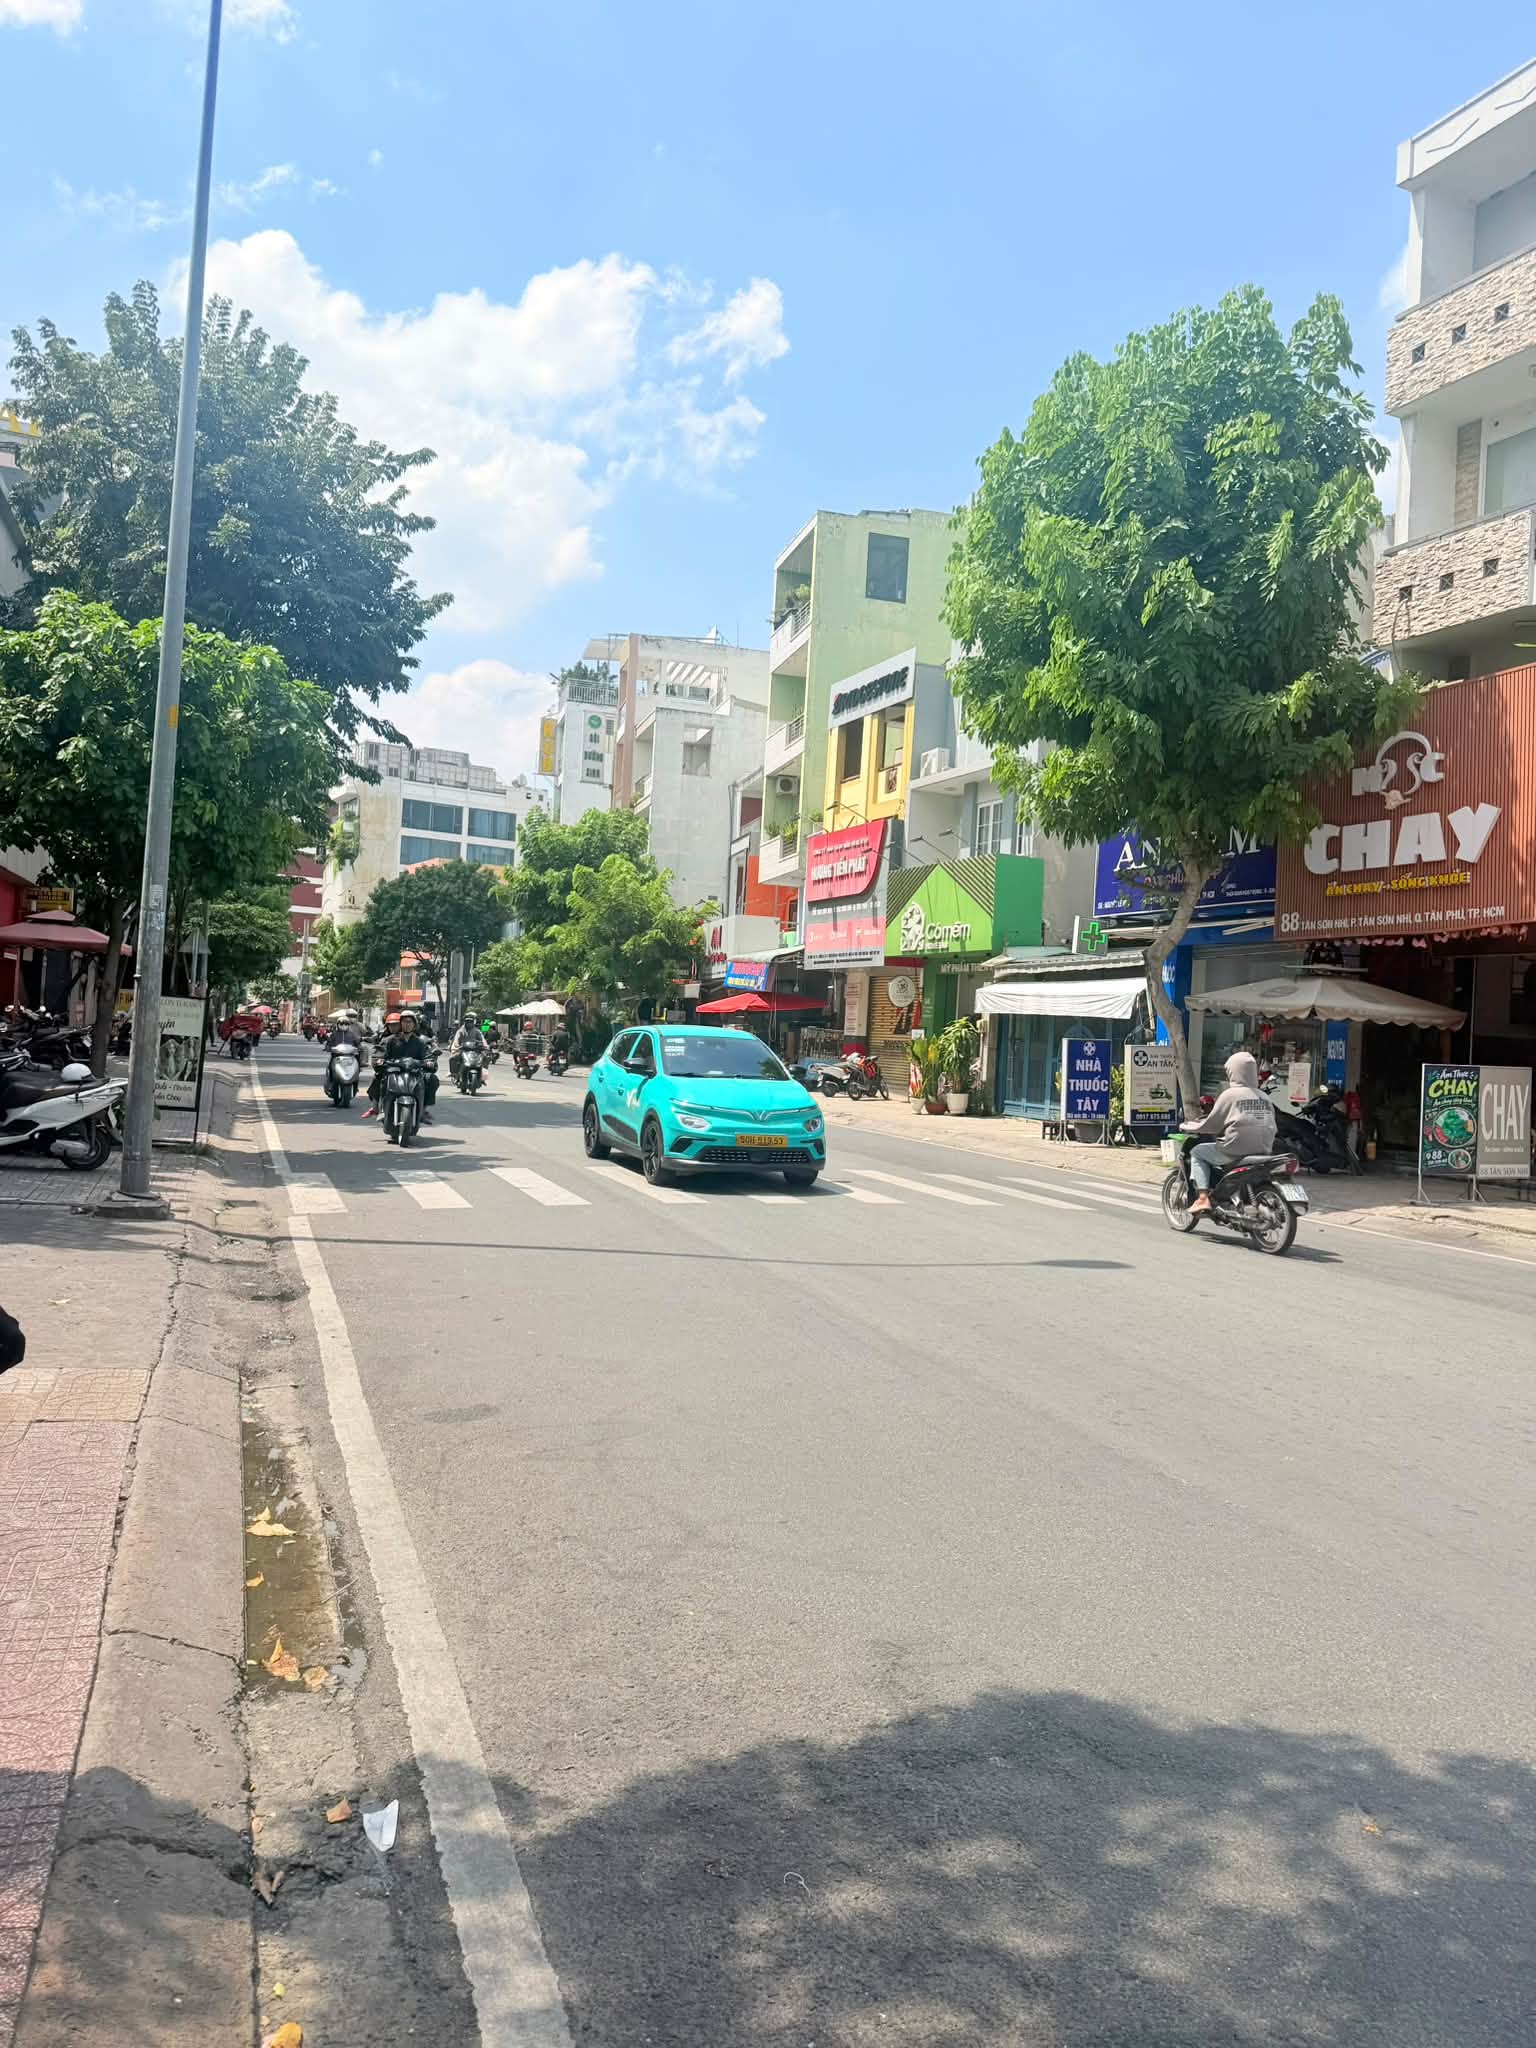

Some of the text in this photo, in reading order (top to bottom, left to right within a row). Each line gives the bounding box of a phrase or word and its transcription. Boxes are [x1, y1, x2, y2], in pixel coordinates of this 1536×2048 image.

[1304, 802, 1502, 875] CHAY
[1346, 880, 1382, 894] CHAY
[1281, 911, 1299, 932] 88
[1483, 905, 1505, 919] HCM
[1076, 1058, 1102, 1072] NHÀ
[1069, 1075, 1109, 1092] THUỐC
[1429, 1079, 1477, 1098] CHAY
[1077, 1096, 1100, 1112] TÂY
[1482, 1083, 1529, 1141] CHAY
[1432, 1150, 1443, 1160] 88
